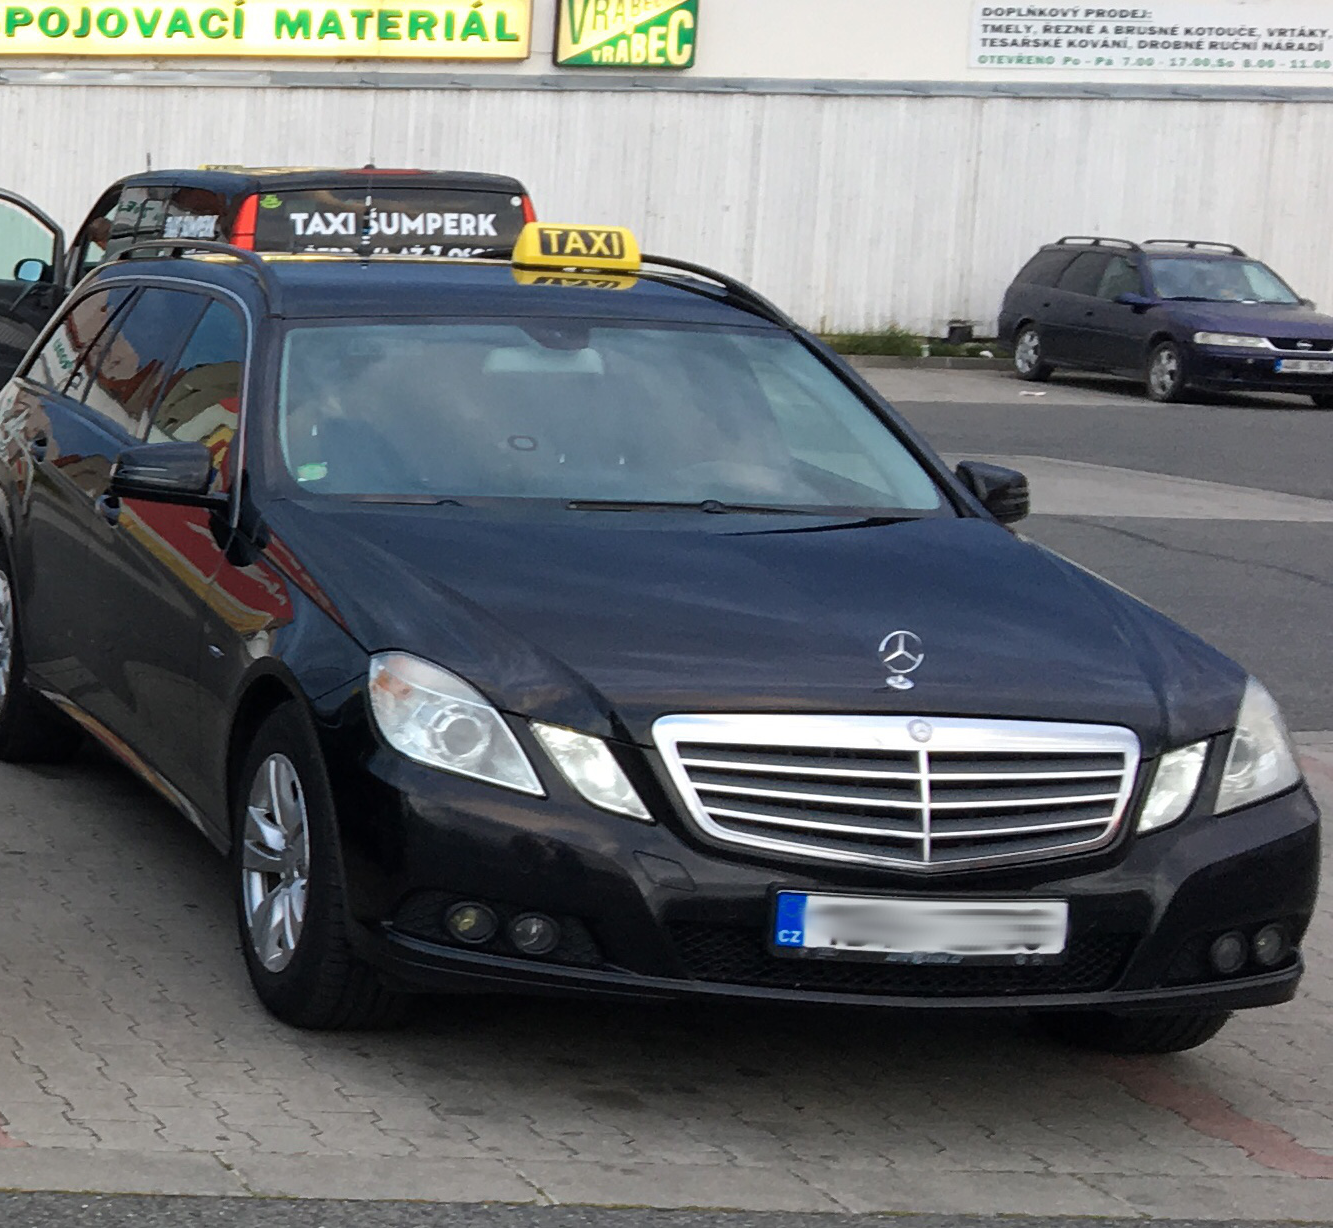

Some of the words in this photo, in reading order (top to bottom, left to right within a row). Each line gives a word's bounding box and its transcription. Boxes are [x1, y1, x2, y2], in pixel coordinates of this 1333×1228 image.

[981, 5, 1081, 18] DOPLŇKOVÝ
[1084, 9, 1153, 19] PRODEJ:
[274, 2, 521, 42] MATERIÁL
[981, 24, 1038, 35] TMELY,
[1042, 22, 1095, 35] ŘEZNÉ
[1098, 25, 1110, 35] A
[1113, 24, 1180, 36] BRUSNÉ
[591, 9, 694, 65] VRABEC
[980, 36, 1064, 48] TESAŘSKÉ
[1137, 38, 1205, 50] DROBNÉ
[1208, 39, 1259, 51] RUČNÍ
[290, 213, 356, 236] TAXI
[542, 229, 621, 256] TAXI
[778, 930, 801, 943] CZ
